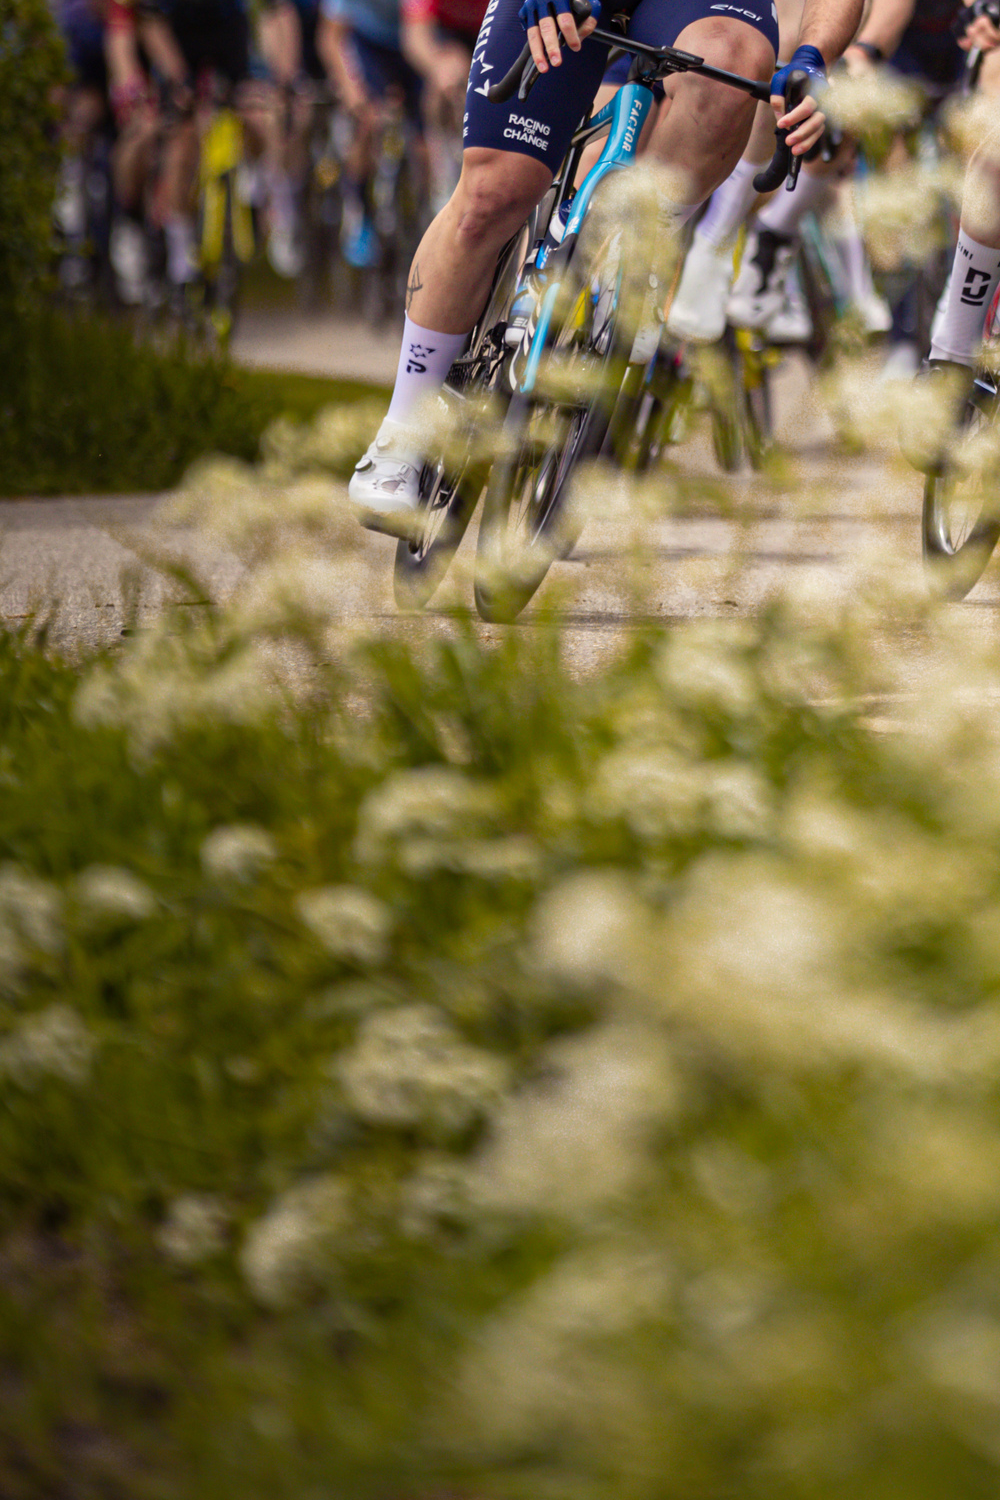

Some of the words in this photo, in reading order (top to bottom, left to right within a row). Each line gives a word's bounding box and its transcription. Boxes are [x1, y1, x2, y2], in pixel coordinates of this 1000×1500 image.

[508, 113, 551, 136] RACING
[523, 126, 536, 136] FOR
[621, 99, 643, 153] FACTOR
[503, 127, 549, 151] CHANGE
